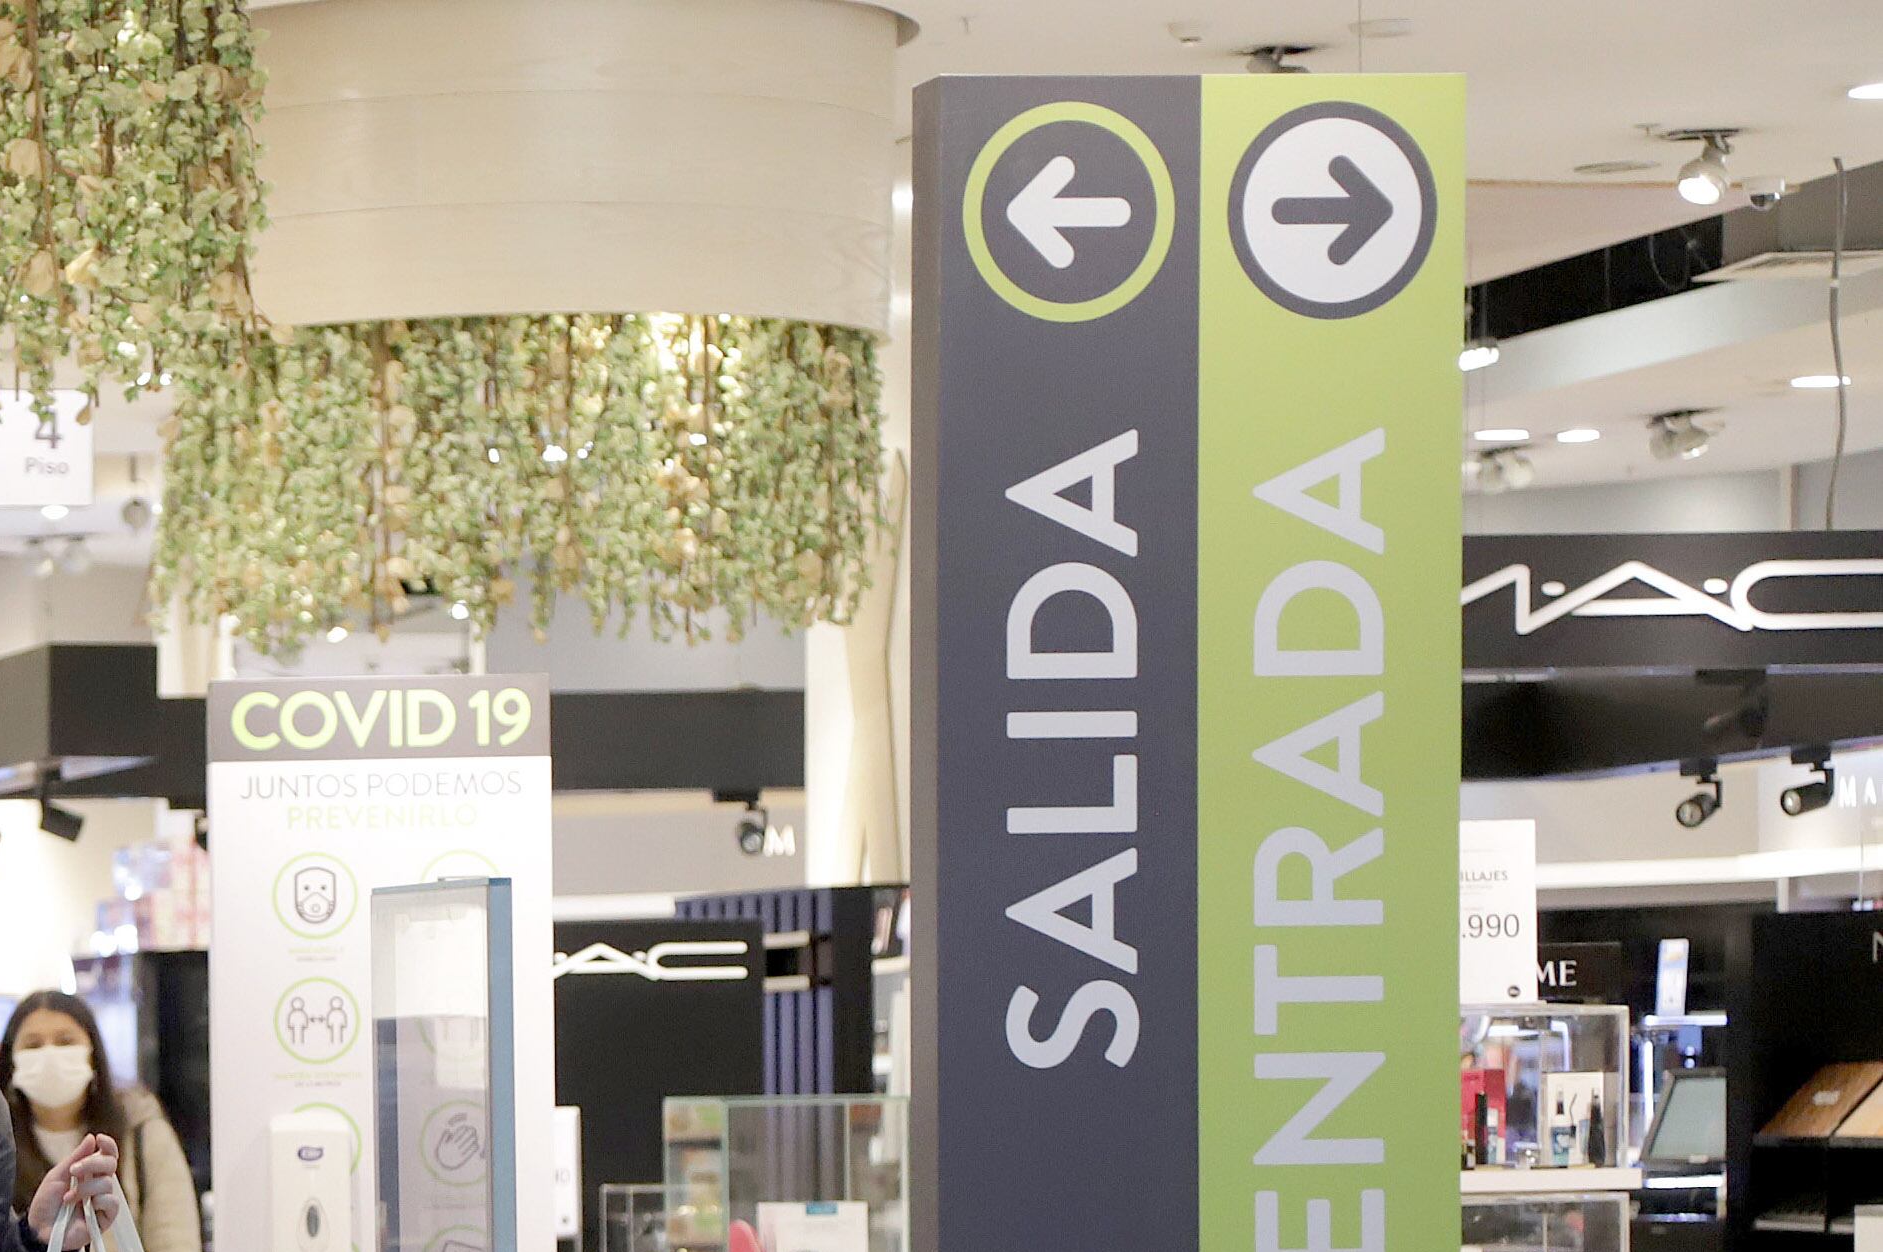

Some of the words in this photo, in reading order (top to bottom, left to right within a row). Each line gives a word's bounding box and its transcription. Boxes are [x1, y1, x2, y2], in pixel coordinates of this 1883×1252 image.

[35, 405, 62, 449] 4
[25, 456, 70, 475] Piso
[230, 688, 458, 751] COVID
[468, 687, 532, 747] 19
[1005, 428, 1140, 1069] SALIDA
[239, 773, 358, 800] JUNTOS
[366, 770, 523, 798] PODEMOS
[286, 802, 478, 831] PREVENIRLO
[1460, 869, 1509, 882] ILLAJES
[1462, 913, 1520, 939] .990
[1536, 959, 1577, 987] ME
